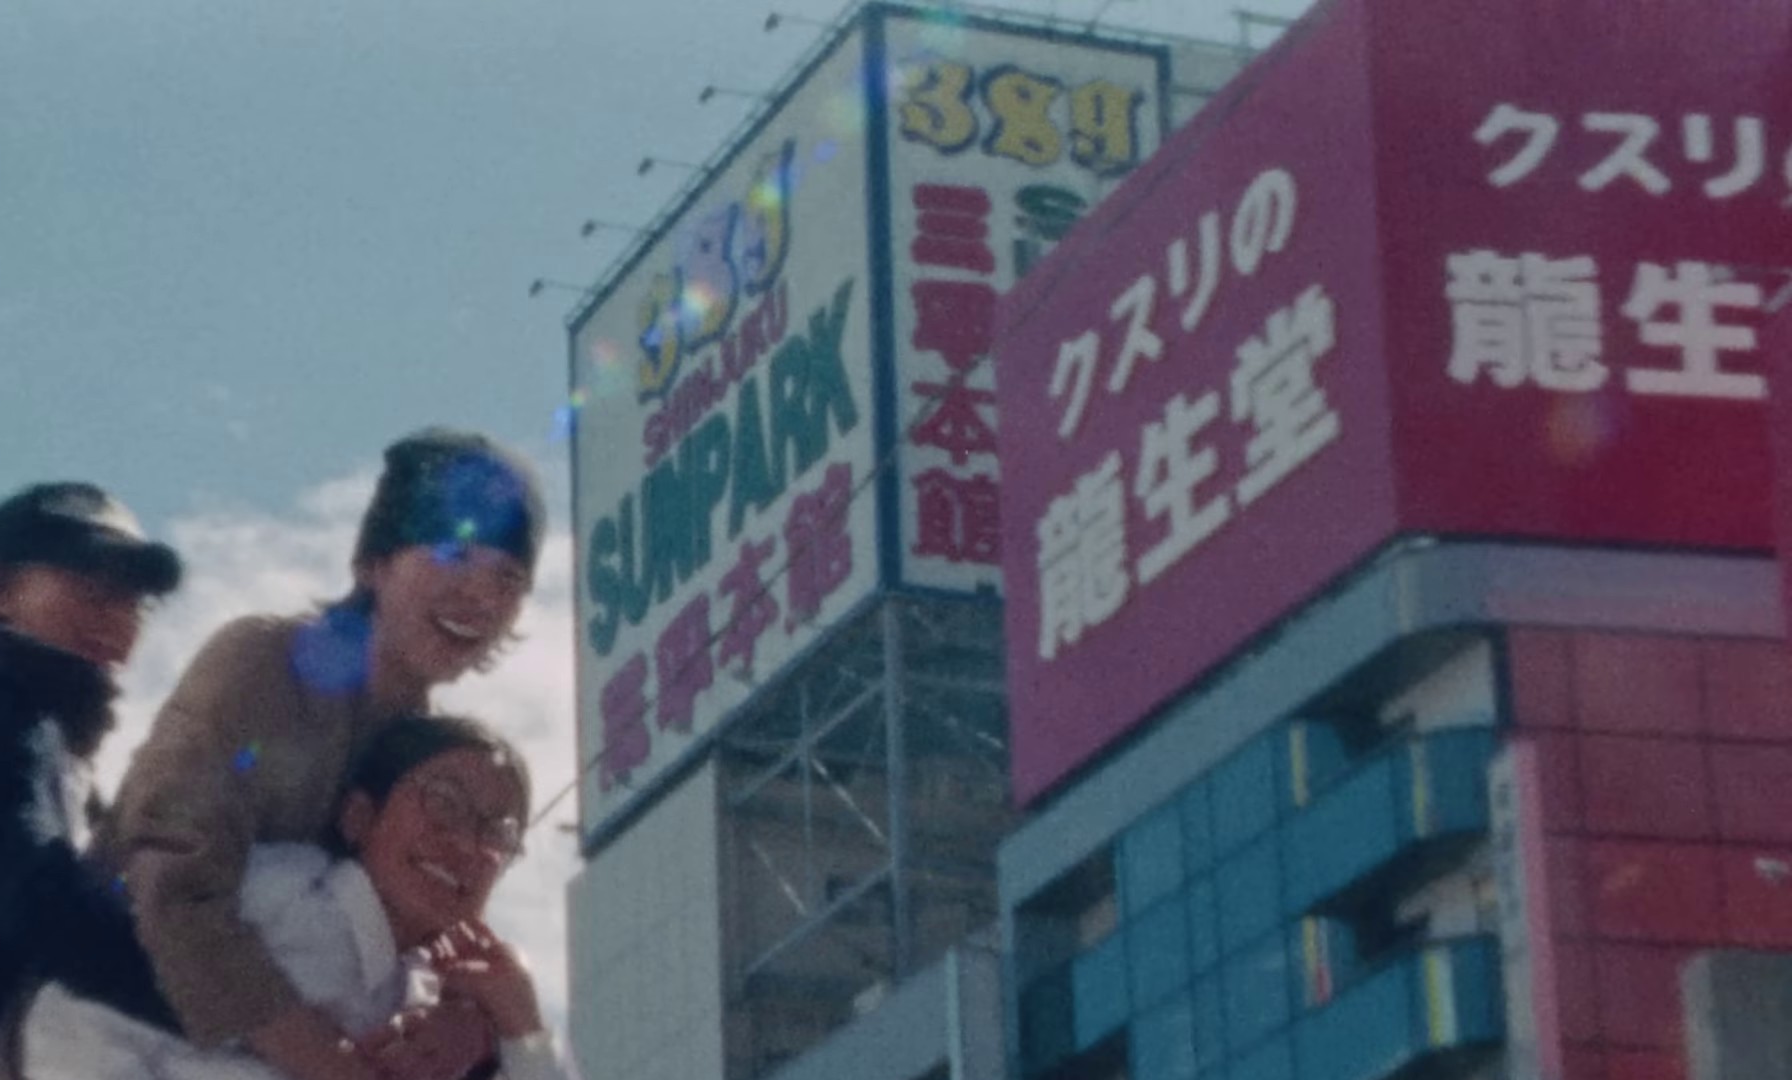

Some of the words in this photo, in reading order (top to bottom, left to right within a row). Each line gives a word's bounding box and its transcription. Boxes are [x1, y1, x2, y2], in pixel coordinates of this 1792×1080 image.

[901, 62, 1144, 177] 389
[1474, 103, 1792, 210] クスリ
[643, 277, 788, 468] SHINJUKU
[911, 182, 1002, 564] 三平本館
[1049, 168, 1297, 439] クスリの
[1445, 248, 1792, 399] 龍生
[587, 276, 859, 657] SUNPARK
[1036, 285, 1339, 659] 龍生堂
[599, 462, 853, 793] 三平本館
